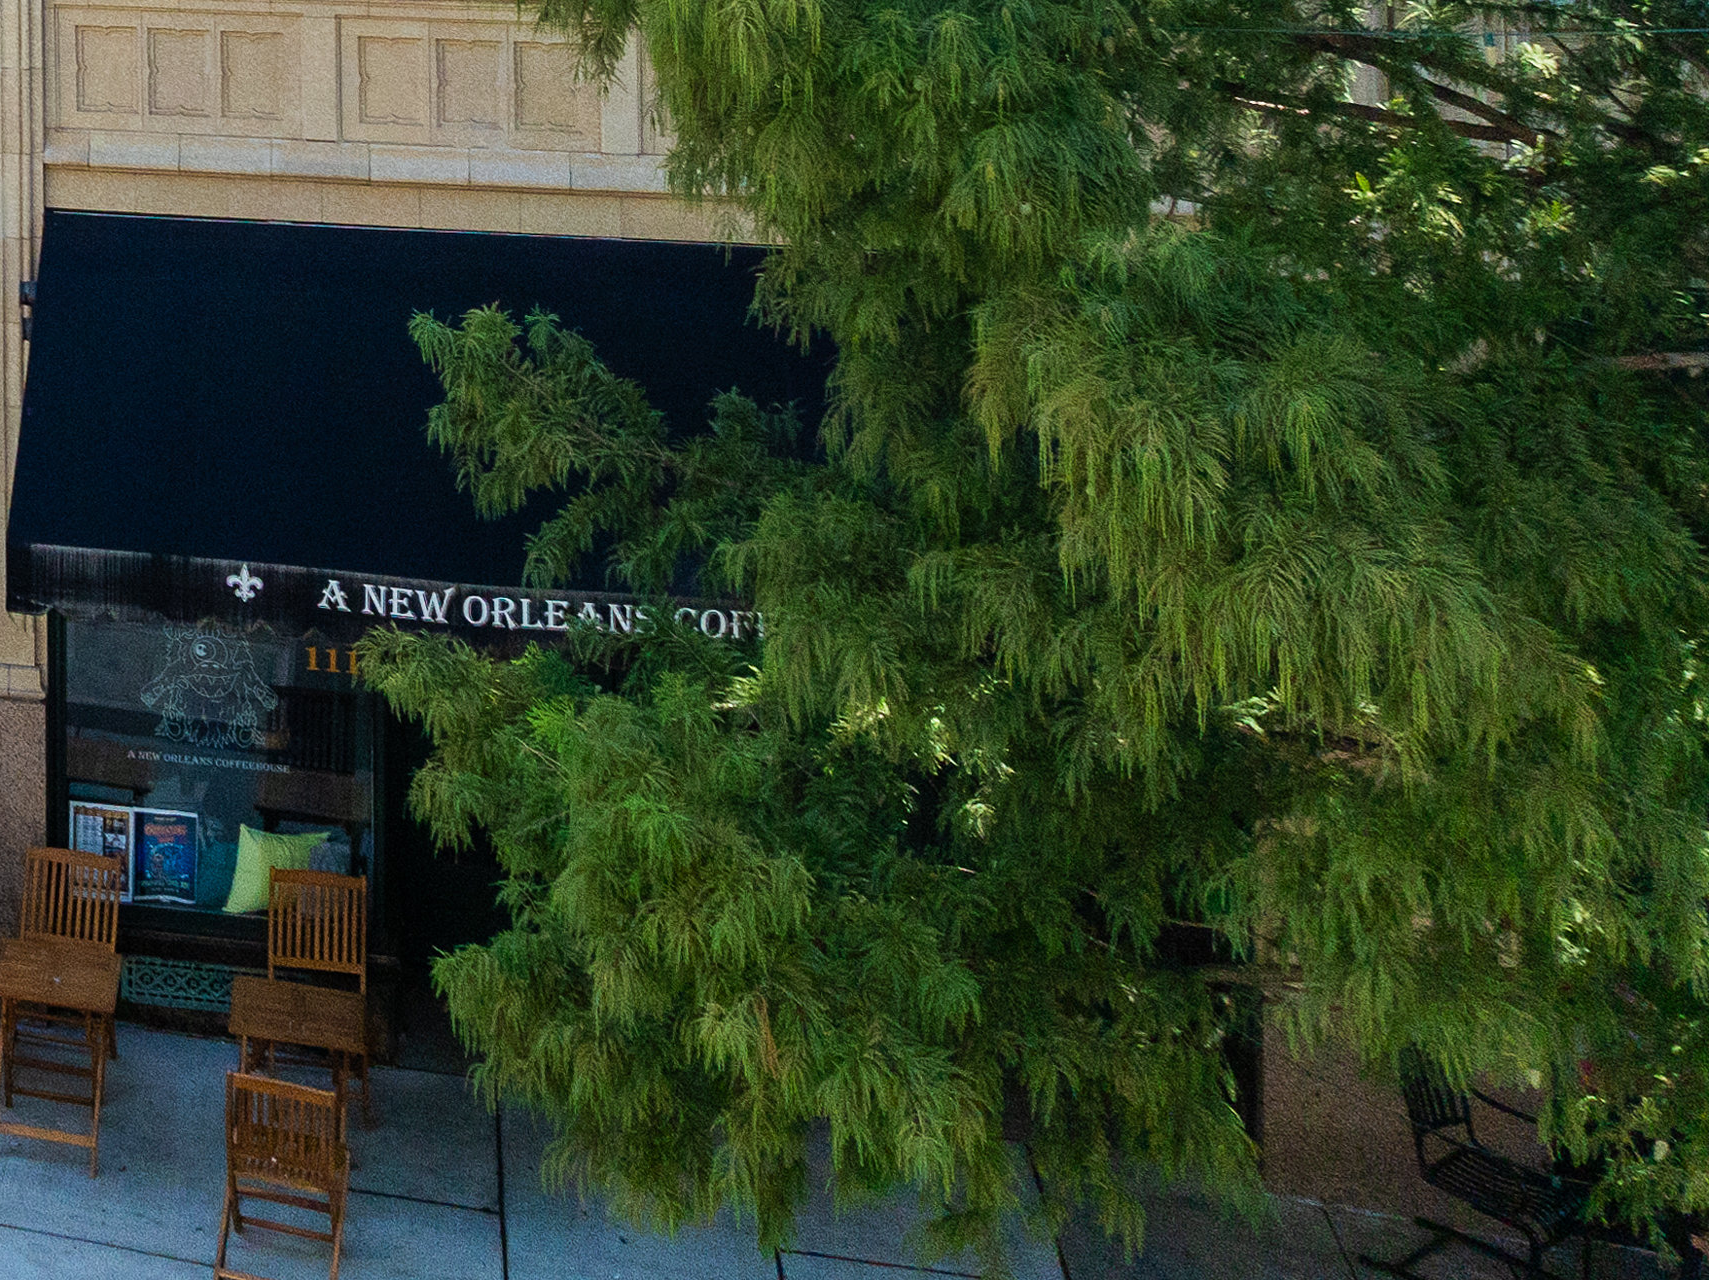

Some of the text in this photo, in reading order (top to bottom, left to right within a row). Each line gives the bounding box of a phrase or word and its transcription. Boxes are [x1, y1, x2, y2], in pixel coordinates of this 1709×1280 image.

[317, 579, 352, 613] A
[361, 584, 457, 625] NEW
[138, 750, 163, 761] NEW
[163, 753, 213, 766] ORLEANS
[215, 758, 290, 774] COFFEEHOUSE
